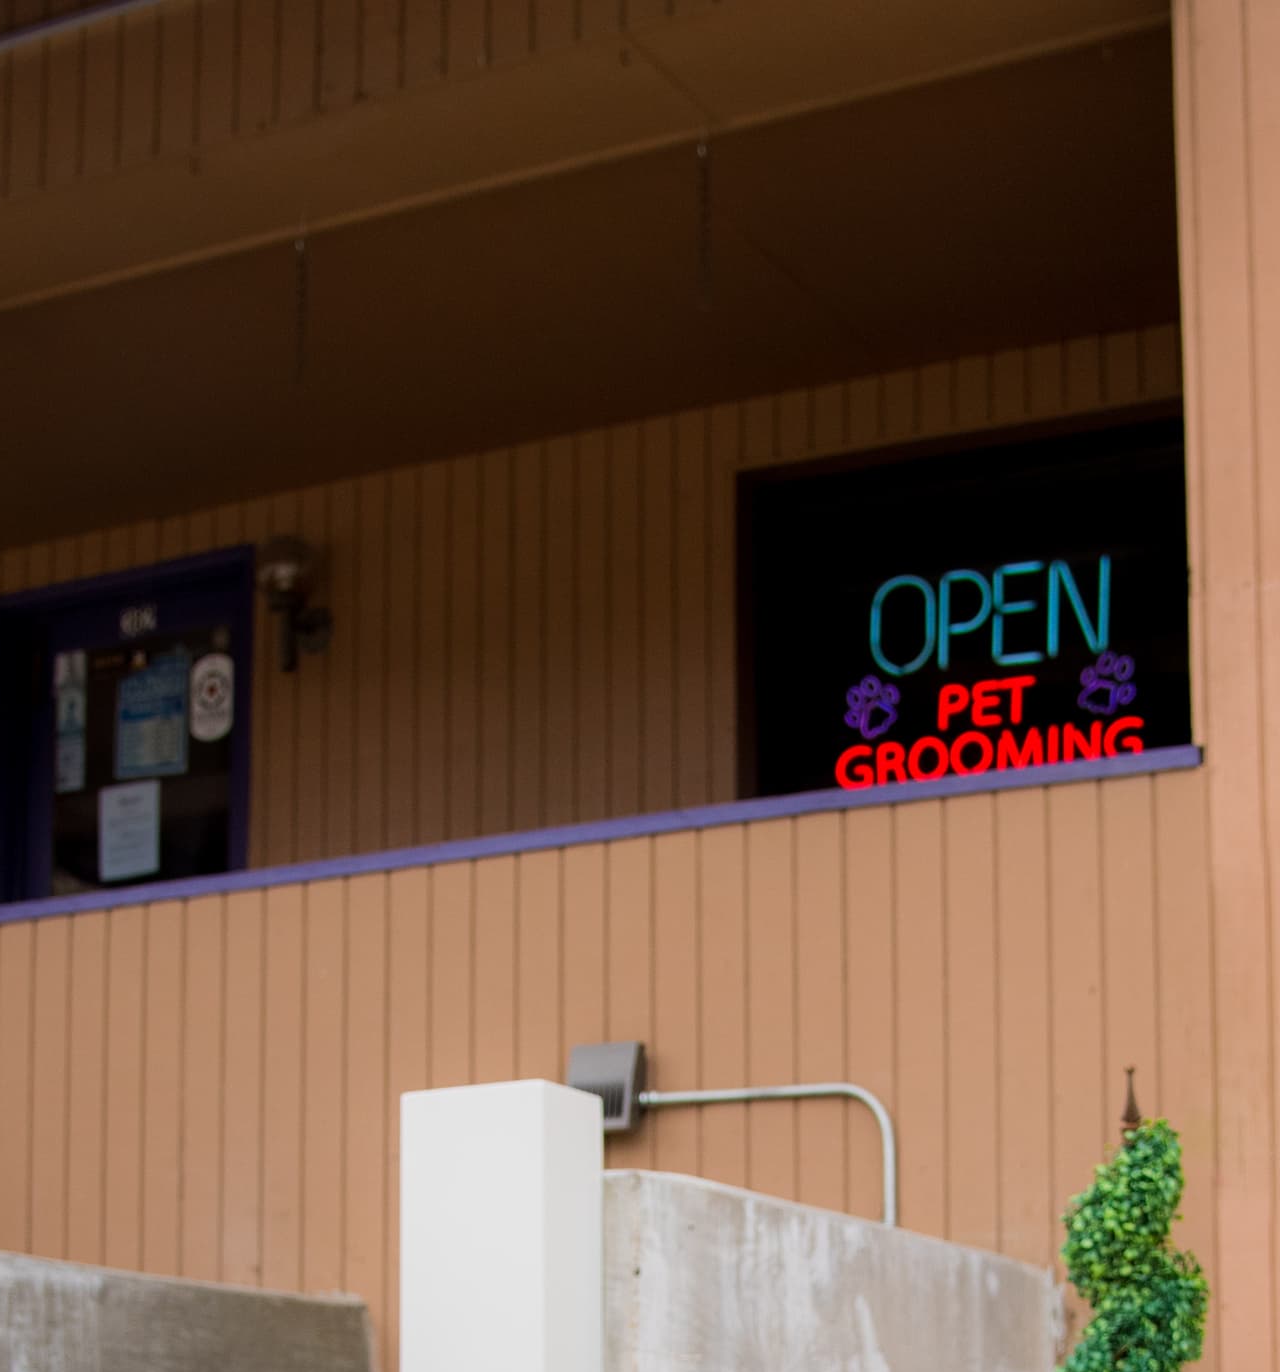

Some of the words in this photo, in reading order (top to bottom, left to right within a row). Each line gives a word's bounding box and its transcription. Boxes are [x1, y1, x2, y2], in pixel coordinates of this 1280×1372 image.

[870, 554, 1111, 676] OPEN
[937, 675, 1036, 731] PET
[834, 715, 1145, 792] GROOMING
